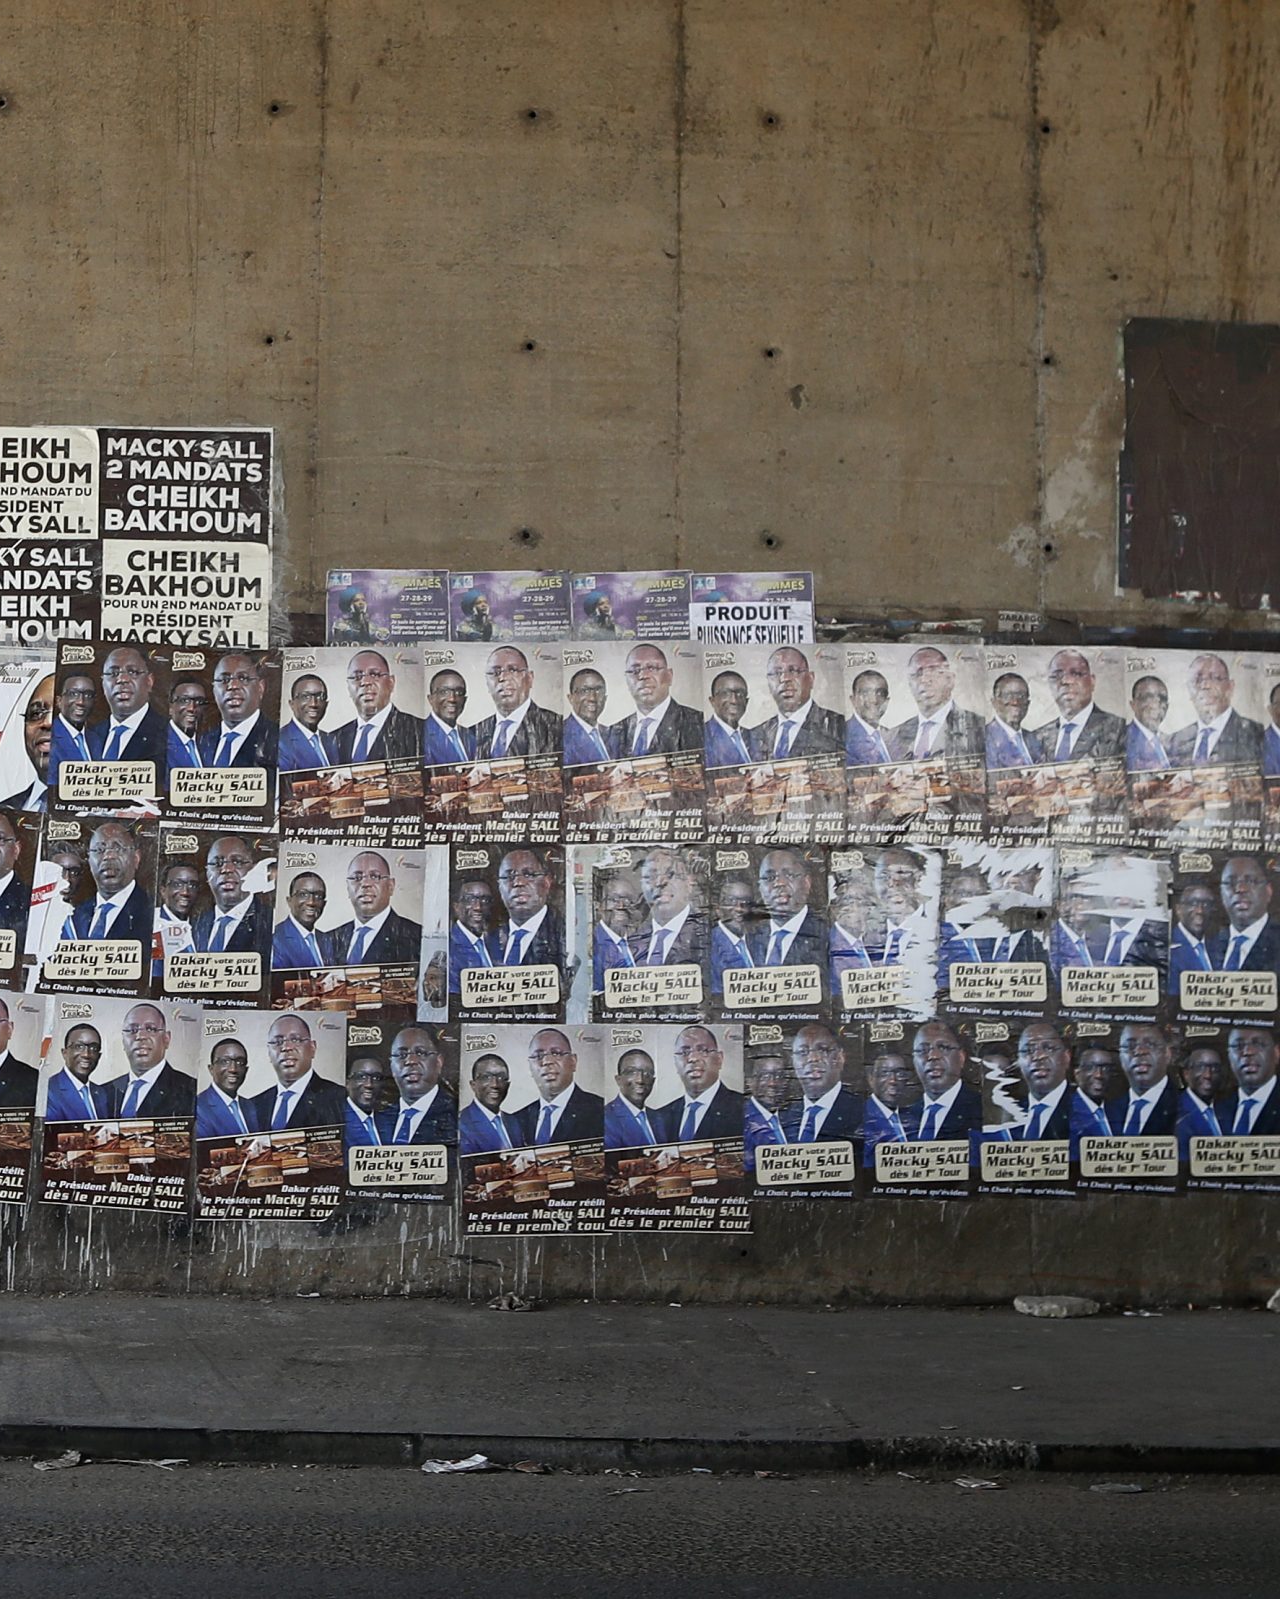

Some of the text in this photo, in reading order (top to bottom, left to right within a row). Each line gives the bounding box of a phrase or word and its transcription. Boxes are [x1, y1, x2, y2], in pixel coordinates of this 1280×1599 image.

[107, 438, 263, 460] MACKY SALL
[106, 460, 262, 482] 2 MANDATS
[20, 487, 71, 497] MANDAT
[72, 487, 92, 497] DU
[127, 486, 239, 509] CHEIKH
[29, 515, 91, 534] SALL
[104, 509, 261, 534] BAKHOUM
[29, 548, 93, 567] SALL
[128, 550, 239, 572] CHEIKH
[105, 574, 261, 598] BAKHOUM
[104, 600, 262, 611] POUR UN 2ND MANDAT DU
[705, 606, 790, 621] PRODUIT
[130, 610, 233, 628] PRÉSIDENT
[103, 628, 261, 649] MACKY SALL
[645, 808, 702, 817] Dakar réélit
[567, 818, 703, 830] le Président Macky SALL
[566, 830, 704, 842] dès le premier tour
[1087, 1140, 1128, 1149] Dakar
[1086, 1149, 1176, 1163] Macky SALL
[127, 1173, 185, 1185] Dakar réélit
[47, 1180, 184, 1197] le Président Macky SALL
[44, 1190, 184, 1209] dès le premier tour
